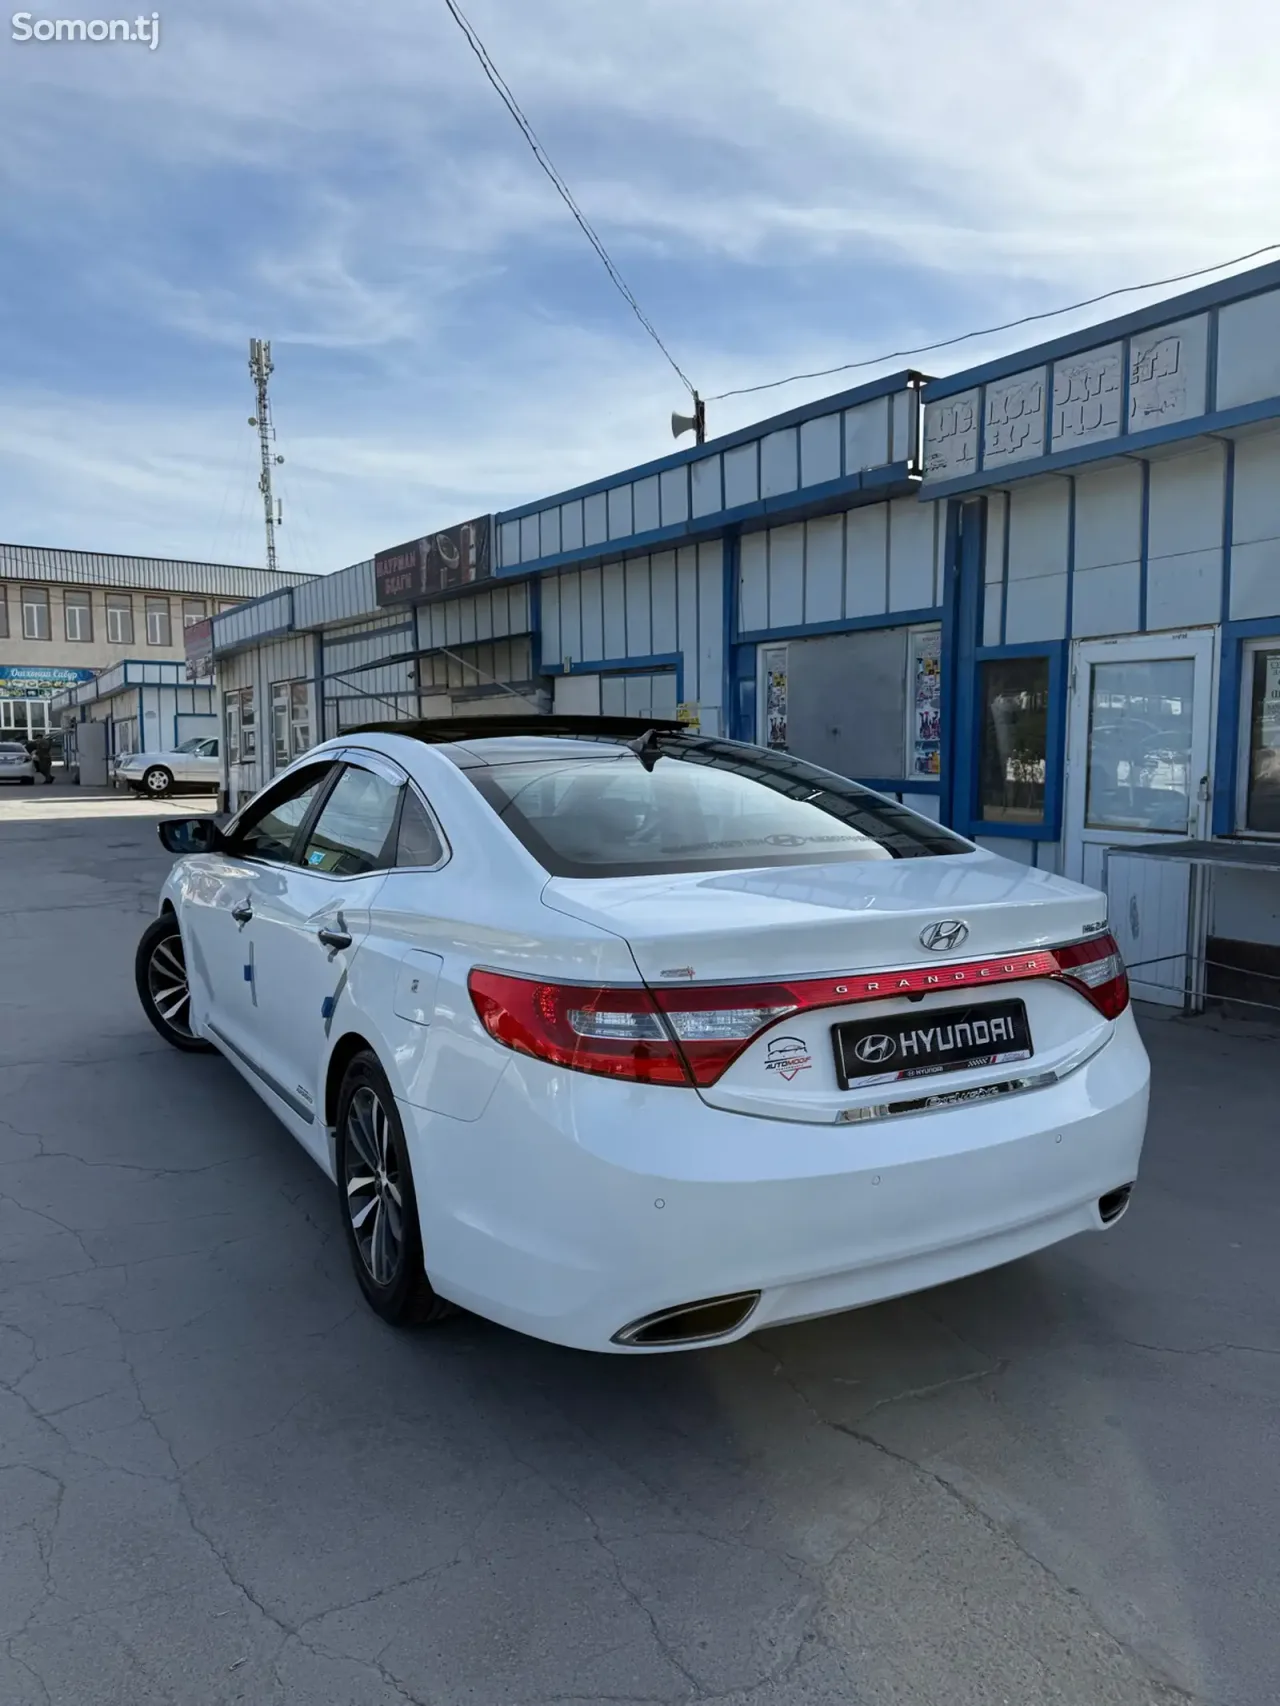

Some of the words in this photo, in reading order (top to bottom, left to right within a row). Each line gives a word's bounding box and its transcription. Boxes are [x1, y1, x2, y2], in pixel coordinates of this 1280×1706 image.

[835, 960, 1038, 993] GRANDEUR
[899, 1016, 1015, 1057] HYUNDAI
[915, 1066, 944, 1076] HYUNDAI
